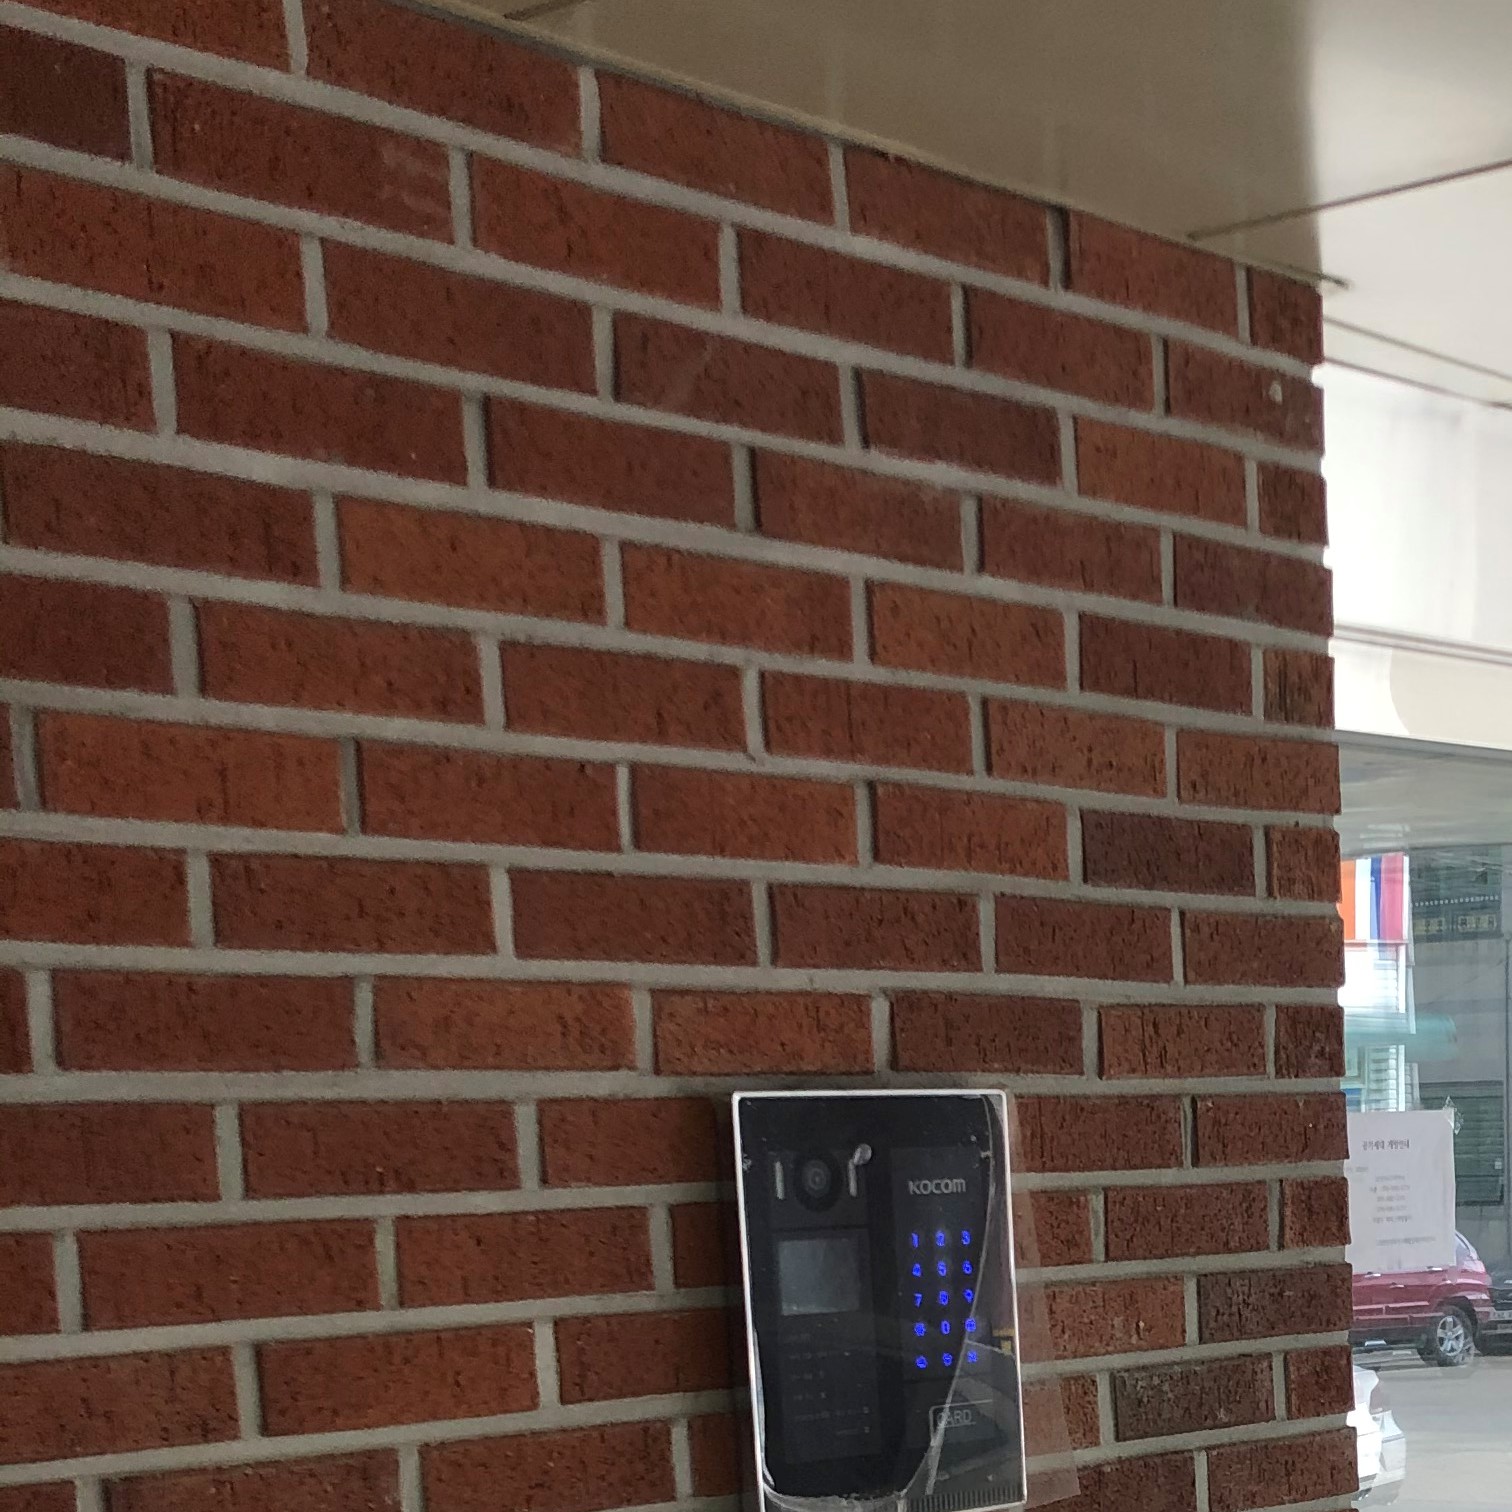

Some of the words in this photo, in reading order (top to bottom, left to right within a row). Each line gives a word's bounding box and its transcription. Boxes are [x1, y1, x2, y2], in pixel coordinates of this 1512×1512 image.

[911, 1232, 920, 1248] 1
[937, 1261, 947, 1277] 5
[962, 1260, 973, 1275] 6
[914, 1292, 923, 1308] 7
